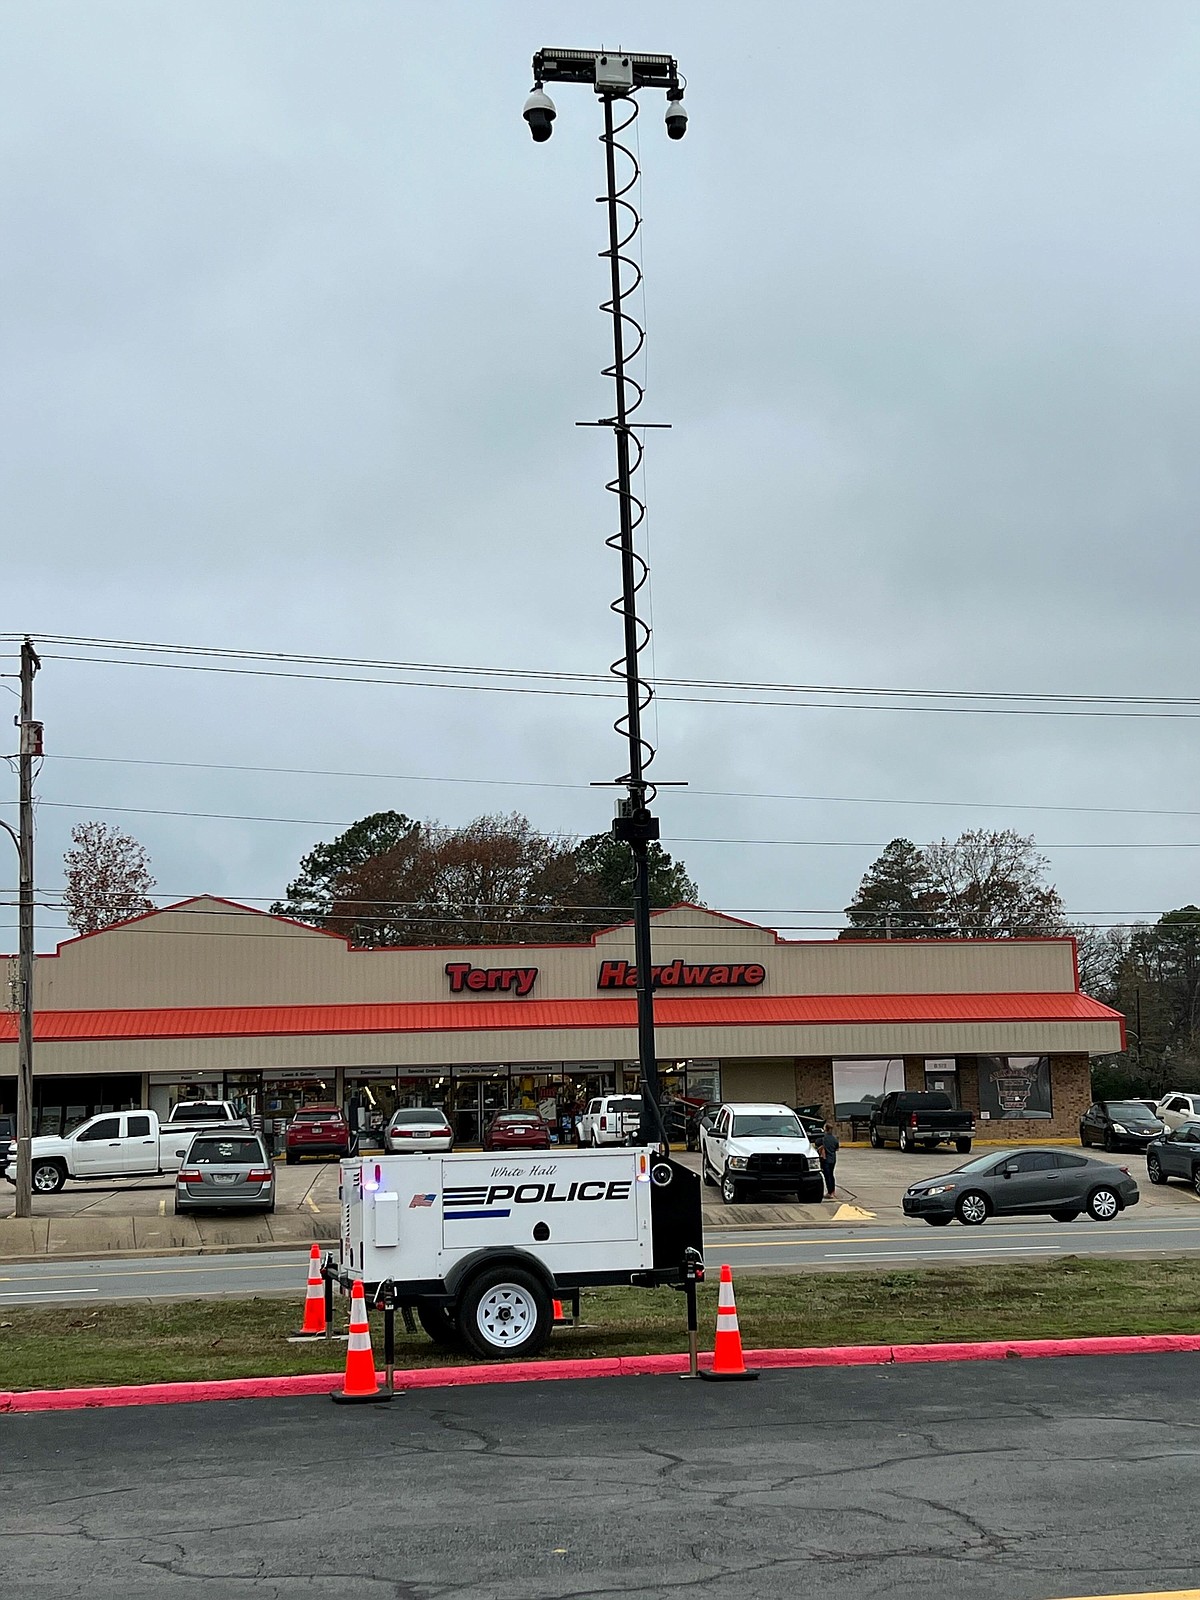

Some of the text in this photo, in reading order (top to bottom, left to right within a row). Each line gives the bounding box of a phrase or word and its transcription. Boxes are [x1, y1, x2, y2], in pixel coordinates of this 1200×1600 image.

[447, 961, 764, 994] Terry Hardware
[490, 1164, 558, 1178] White Hall
[485, 1180, 633, 1205] POLICE
